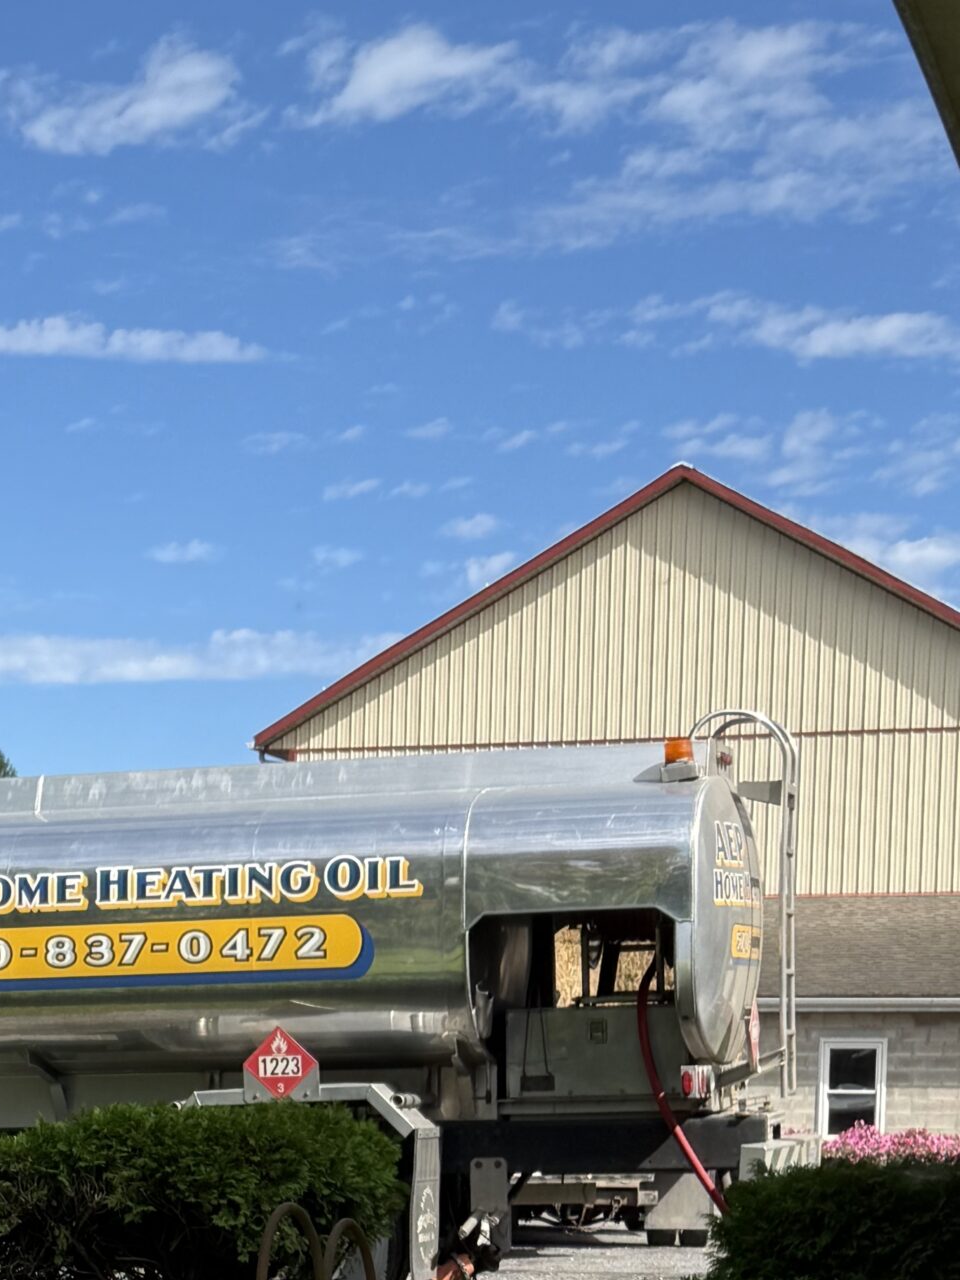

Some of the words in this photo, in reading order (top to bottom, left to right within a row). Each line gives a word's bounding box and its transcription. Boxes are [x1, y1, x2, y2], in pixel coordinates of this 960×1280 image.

[714, 820, 744, 868] AEP
[95, 859, 320, 910] HEATING
[324, 854, 424, 901] OIL
[713, 868, 744, 907] HOME
[260, 1056, 301, 1077] 1223
[276, 1082, 285, 1093] 3
